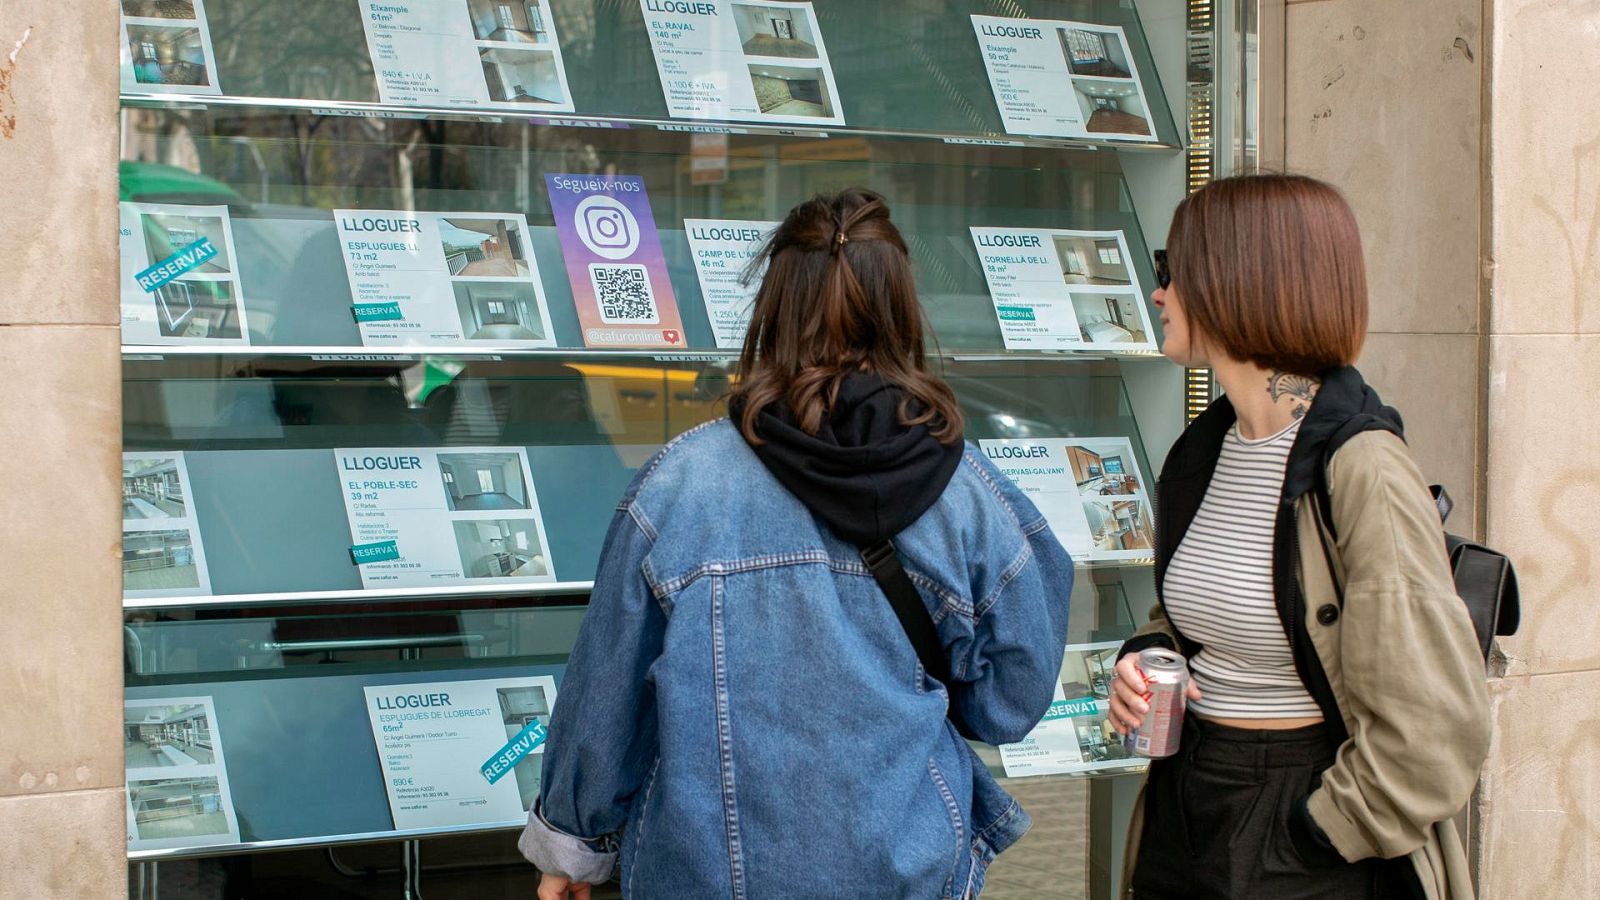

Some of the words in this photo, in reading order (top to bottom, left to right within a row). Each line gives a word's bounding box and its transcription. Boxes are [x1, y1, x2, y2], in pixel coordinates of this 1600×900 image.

[370, 3, 409, 13] Eixample
[646, 0, 718, 16] LLOGUER
[652, 21, 664, 29] EL
[666, 22, 696, 31] RAVAL
[981, 24, 1043, 40] LLOGUER
[383, 70, 397, 78] 840
[554, 176, 641, 193] Segueix-nos
[343, 217, 422, 233] LLOGUER
[692, 228, 763, 242] LLOGUER
[978, 234, 1042, 248] LLOGUER
[348, 241, 407, 251] ESPLUGUES
[350, 252, 361, 260] 73
[698, 250, 723, 259] CAMP
[725, 251, 738, 259] DE
[1027, 256, 1039, 264] DE
[140, 241, 215, 290] RESERVAT
[588, 330, 661, 344] @cafuronline
[986, 446, 1049, 459] LLOGUER
[343, 456, 423, 471] LLOGUER
[349, 481, 362, 489] EL
[363, 481, 418, 490] POBLE-SEC
[351, 492, 362, 500] 39
[353, 545, 398, 557] RESERVAT
[376, 693, 453, 711] LLOGUER
[1045, 701, 1095, 717] ESERVAT
[380, 712, 430, 723] ESPLUGUES
[431, 711, 443, 720] DE
[444, 708, 492, 720] LLOBREGAT
[484, 722, 545, 781] RESERVAT
